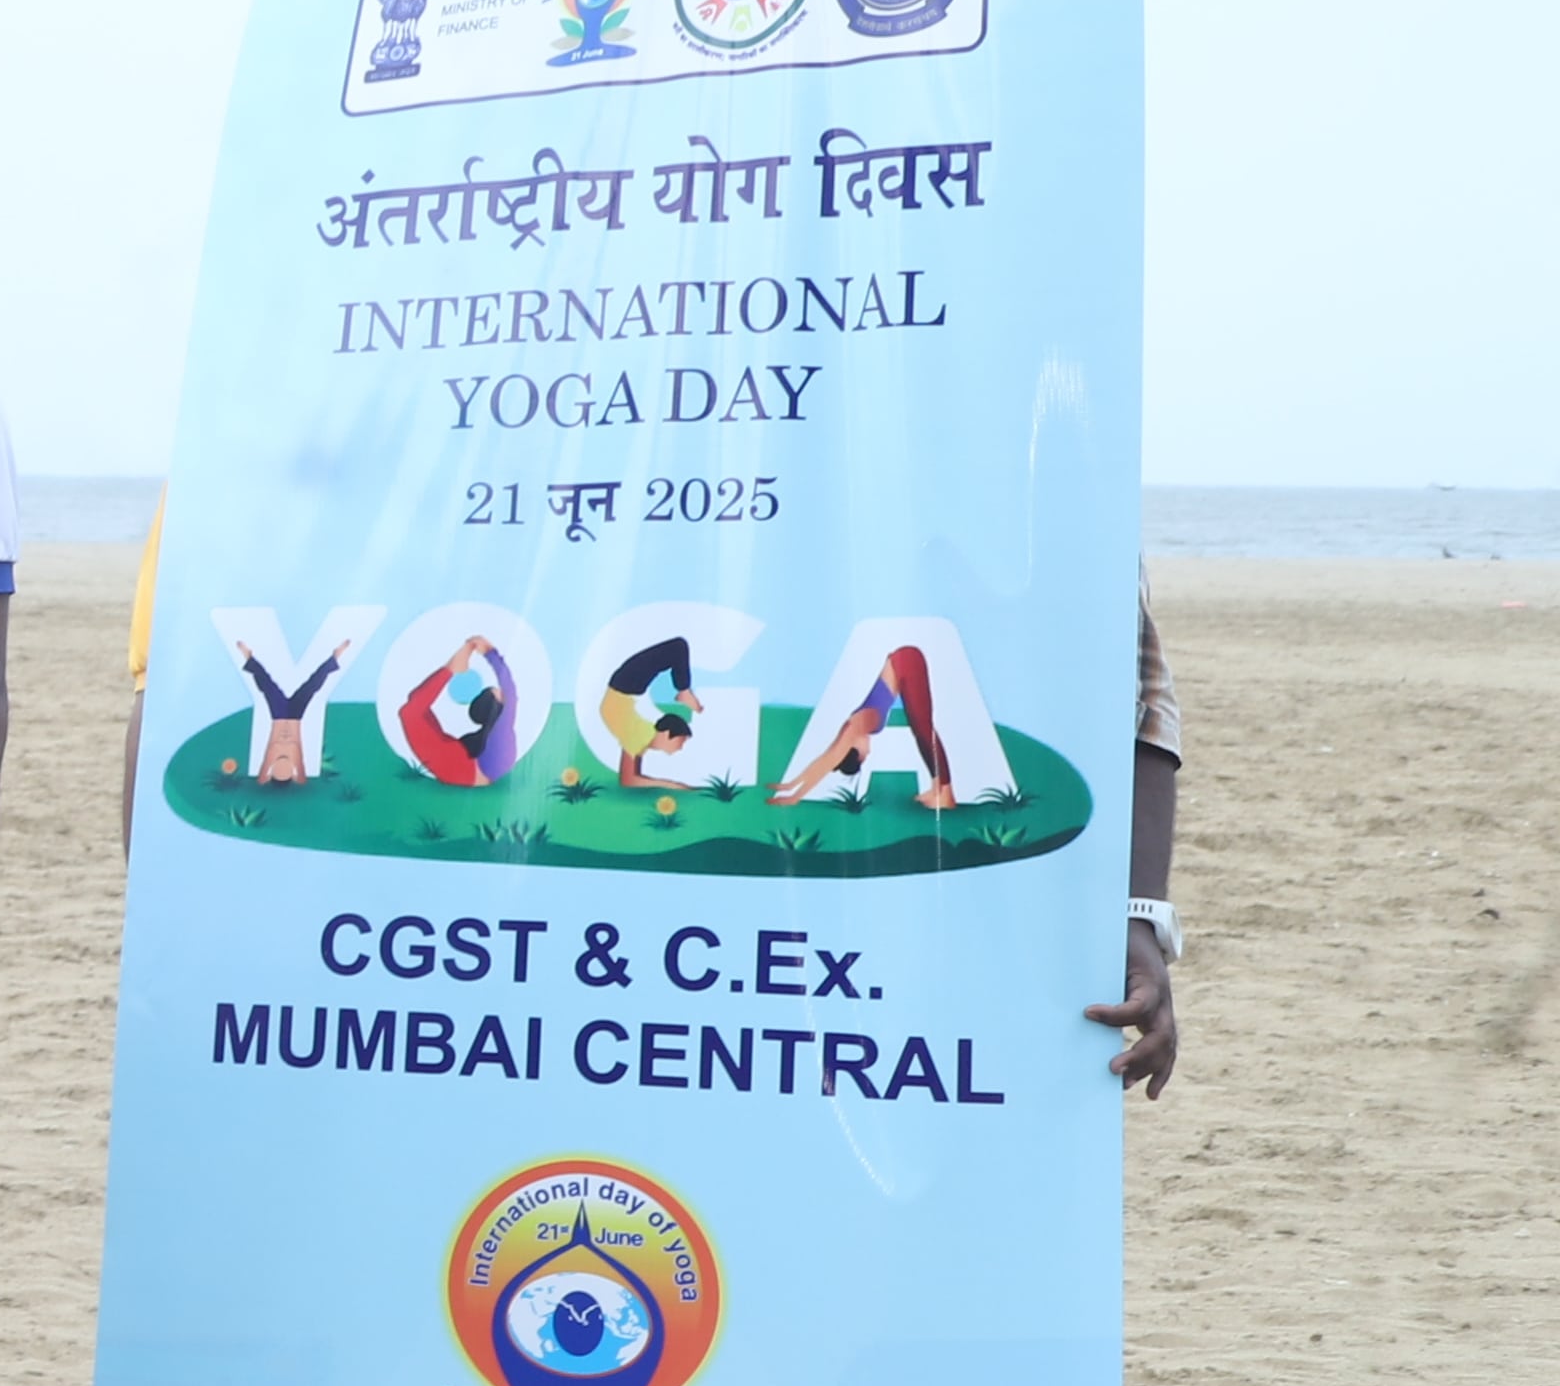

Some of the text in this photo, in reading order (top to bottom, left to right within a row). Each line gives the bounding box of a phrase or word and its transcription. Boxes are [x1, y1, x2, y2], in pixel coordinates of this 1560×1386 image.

[437, 16, 499, 37] FINANCE
[315, 128, 993, 250] अंतर्राष्ट्रीय योग दिवस
[332, 270, 947, 355] INTERNATIONAL
[443, 365, 823, 430] YOGA DAY
[463, 476, 780, 542] 21 जून 2025
[210, 601, 1017, 807] YOGA
[318, 912, 885, 1001] CGST & C.Ex.
[211, 1002, 1006, 1105] MUMBAI CENTRAL
[469, 1177, 699, 1303] International day of yoga
[594, 1227, 644, 1248] June
